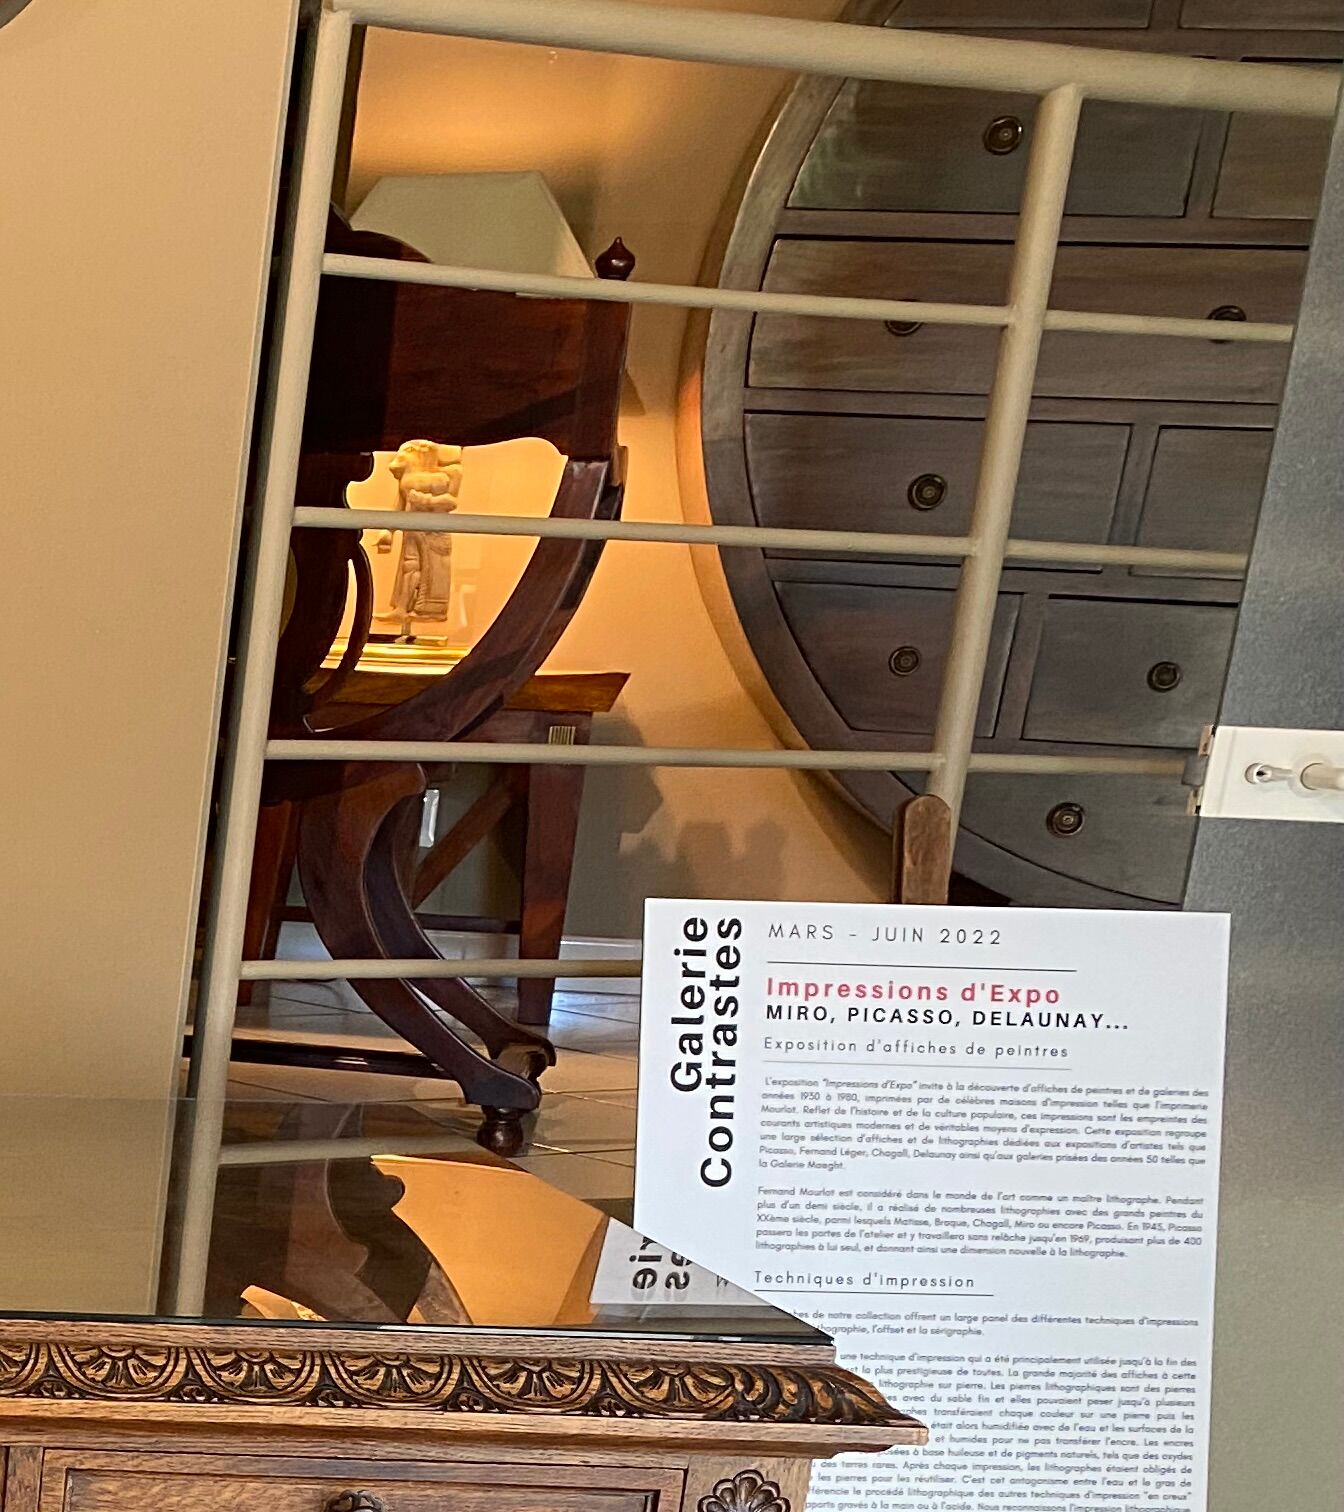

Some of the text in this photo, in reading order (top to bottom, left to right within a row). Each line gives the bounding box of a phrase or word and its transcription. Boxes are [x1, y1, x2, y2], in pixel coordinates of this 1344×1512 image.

[768, 924, 834, 941] MARS
[872, 927, 925, 944] JUIN
[940, 928, 1002, 945] 2022
[766, 977, 1061, 1005] Impressions d'Expo
[670, 917, 708, 1092] Galerie
[766, 1005, 1129, 1031] MIRO, PICASSO, DELAUNAY...
[700, 917, 742, 1188] Contrastes
[764, 1037, 1069, 1062] Exposition d'affiches de peintres
[758, 1157, 767, 1167] la
[770, 1157, 805, 1168] Galerie
[755, 1271, 975, 1290] Techniques d'impression
